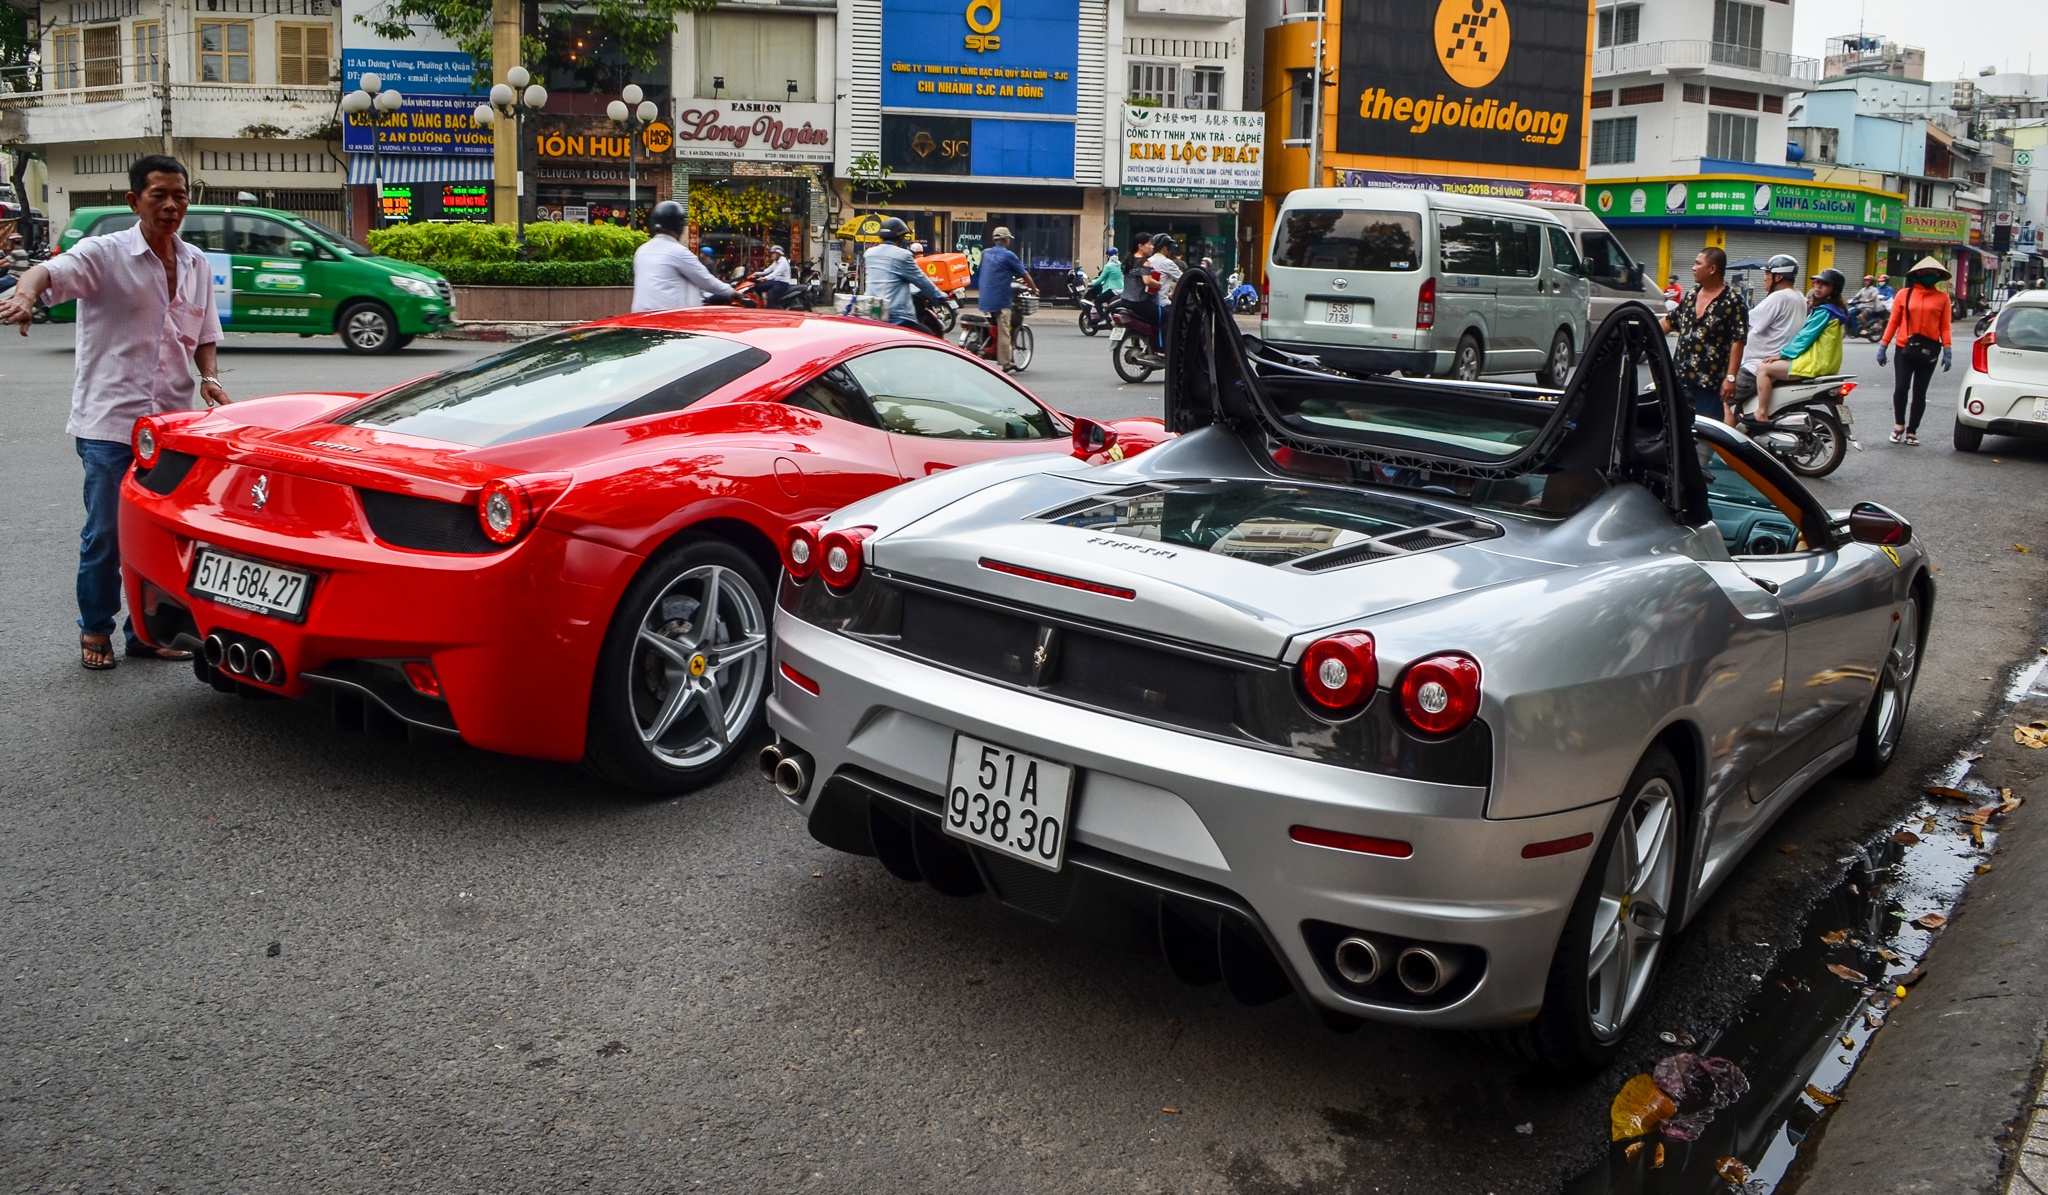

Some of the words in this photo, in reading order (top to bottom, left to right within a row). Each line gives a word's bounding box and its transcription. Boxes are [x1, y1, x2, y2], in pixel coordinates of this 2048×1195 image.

[356, 59, 366, 67] An
[368, 59, 390, 70] Dương
[417, 60, 443, 71] Phường
[452, 62, 470, 72] Quận
[892, 60, 910, 72] CÔNG
[913, 64, 921, 72] TY
[924, 64, 941, 73] TNHH
[943, 66, 957, 74] MTV
[960, 64, 978, 76] VÀNG
[979, 68, 992, 79] BẠC
[994, 66, 1003, 77] ĐÁ
[1005, 67, 1018, 78] QUÝ
[1020, 67, 1032, 78] SÀI
[1033, 68, 1047, 79] GÒN
[1055, 72, 1068, 81] SJC
[918, 81, 935, 92] CHI
[938, 79, 972, 94] NHÁNH
[976, 84, 995, 96] SJC
[999, 85, 1013, 97] AN
[1017, 84, 1043, 98] ĐÔNG
[731, 102, 782, 113] FASHION
[1360, 87, 1568, 144] thegioididong
[411, 110, 441, 128] VÀNG
[445, 113, 466, 131] BẠC
[389, 132, 406, 142] AN
[410, 131, 451, 143] DƯƠNG
[454, 132, 494, 144] VƯƠNG
[680, 109, 751, 148] Long
[752, 115, 829, 150] Ngân
[1126, 127, 1148, 138] CÔNG
[1152, 130, 1161, 139] TY
[1163, 131, 1185, 140] TNHH
[1190, 132, 1206, 141] XNK
[1210, 131, 1224, 141] TRÀ
[1521, 134, 1545, 143] .com
[942, 139, 969, 159] SJC
[1130, 143, 1166, 159] KIM
[1172, 140, 1207, 164] LỘC
[1212, 143, 1260, 163] PHÁT
[1442, 182, 1467, 194] TRÚNG
[1468, 184, 1490, 194] 2018
[1504, 186, 1524, 197] VÀNG
[1776, 186, 1800, 196] CÔNG
[1820, 189, 1832, 198] CỔ
[1332, 304, 1348, 313] 53S
[1328, 313, 1349, 323] 7138
[2035, 410, 2048, 420] 95
[200, 556, 302, 607] 51A-684.27
[978, 745, 1037, 806] 51A
[950, 786, 1060, 859] 938.30
